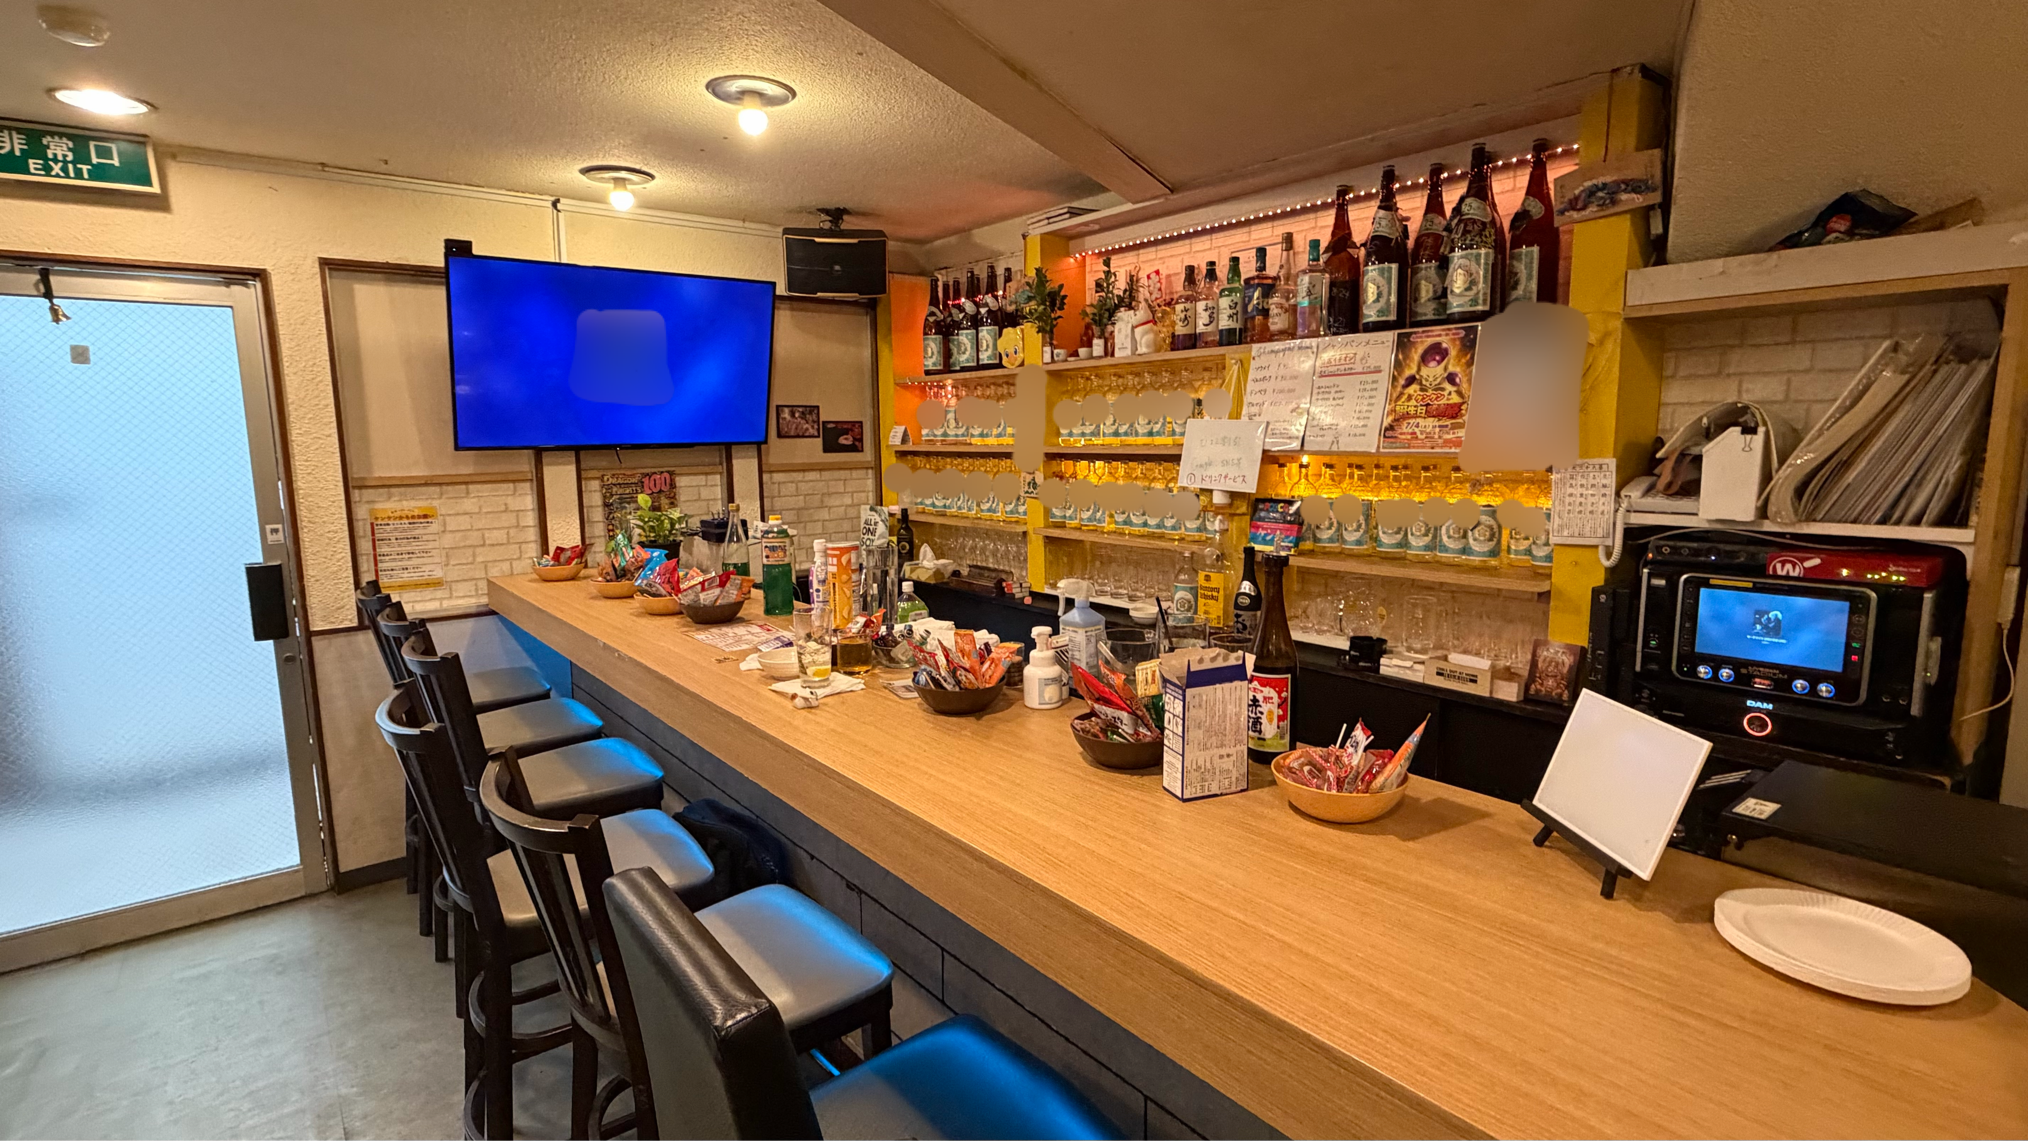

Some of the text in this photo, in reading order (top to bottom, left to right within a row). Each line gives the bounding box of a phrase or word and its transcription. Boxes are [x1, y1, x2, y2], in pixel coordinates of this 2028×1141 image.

[0, 130, 120, 167] 非常口
[28, 158, 92, 179] EXIT
[1179, 305, 1191, 328] 山崎
[1202, 302, 1216, 327] 知多
[1226, 299, 1239, 324] 白州
[1405, 421, 1420, 430] 7/4
[642, 472, 671, 495] 100
[864, 518, 873, 527] ALL
[862, 526, 877, 537] ONE
[860, 537, 875, 548] SOY
[1199, 584, 1220, 593] Suntory
[1199, 591, 1219, 602] Whisky
[1746, 699, 1773, 710] DAM
[1248, 695, 1264, 735] 赤酒
